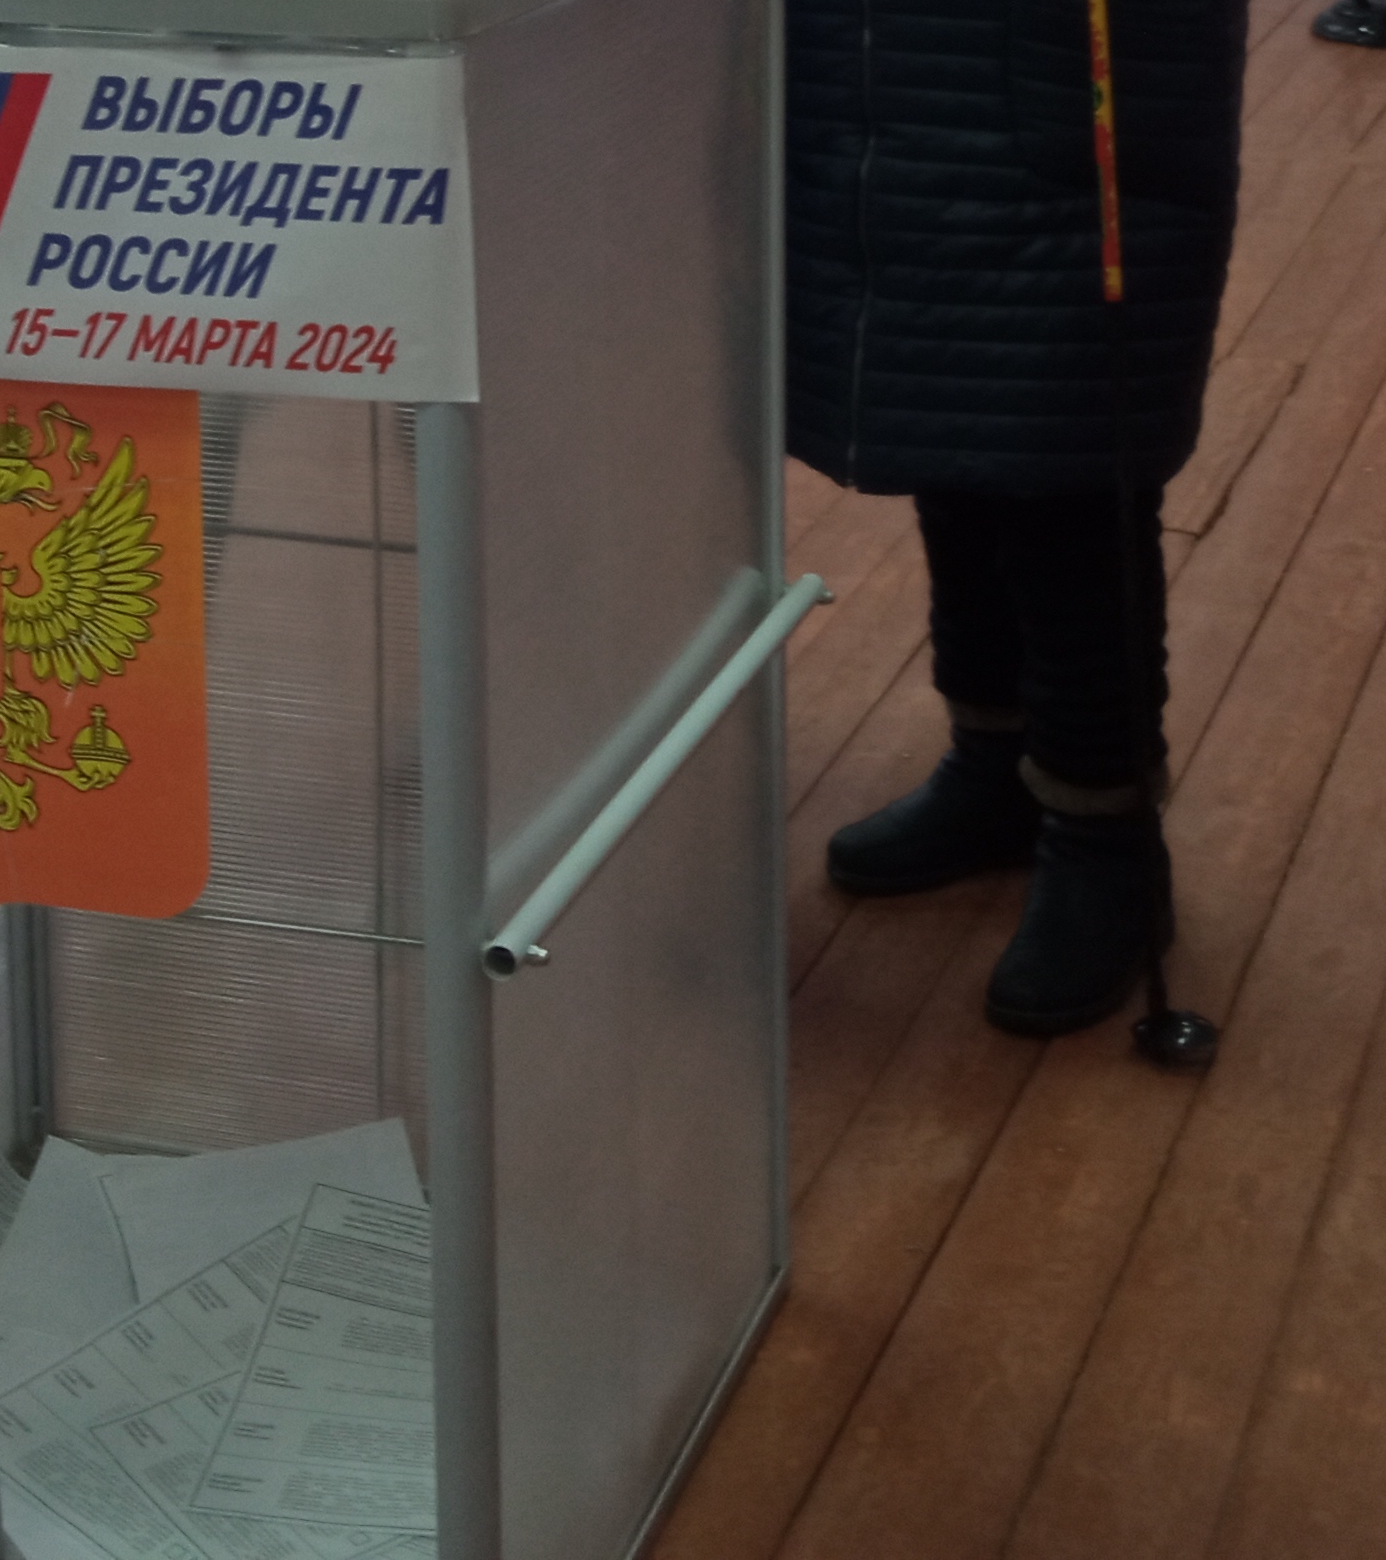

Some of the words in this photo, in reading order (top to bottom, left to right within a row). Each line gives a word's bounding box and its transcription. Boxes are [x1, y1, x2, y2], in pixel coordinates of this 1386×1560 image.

[80, 74, 363, 142] ВЫБОРЫ
[52, 153, 451, 230] ПРЕЗИДЕНТА
[25, 231, 278, 300] РОССИИ
[129, 314, 278, 369] МАРТА
[285, 322, 397, 375] 2024
